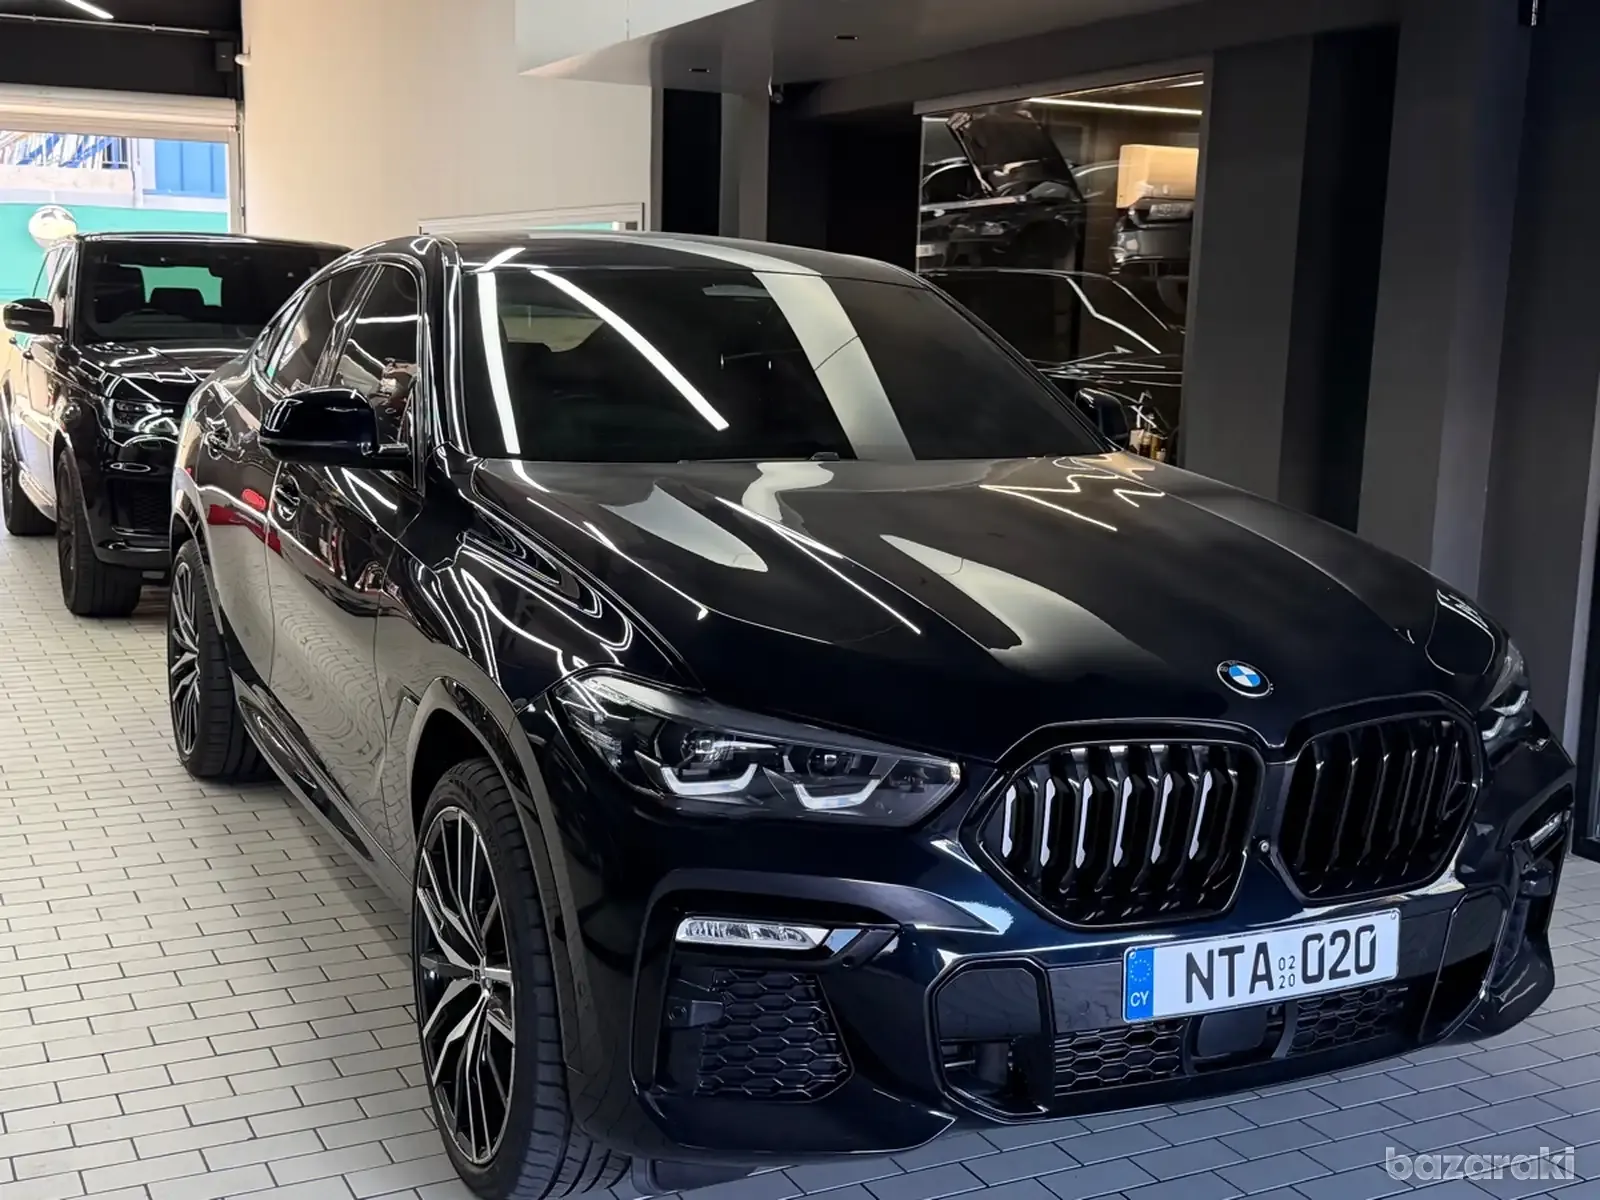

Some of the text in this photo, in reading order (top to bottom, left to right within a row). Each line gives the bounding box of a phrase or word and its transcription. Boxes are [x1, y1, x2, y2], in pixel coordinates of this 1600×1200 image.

[1185, 925, 1376, 1004] NTA 020
[1278, 955, 1296, 970] 02
[1278, 974, 1296, 989] 20
[1130, 991, 1149, 1007] CY
